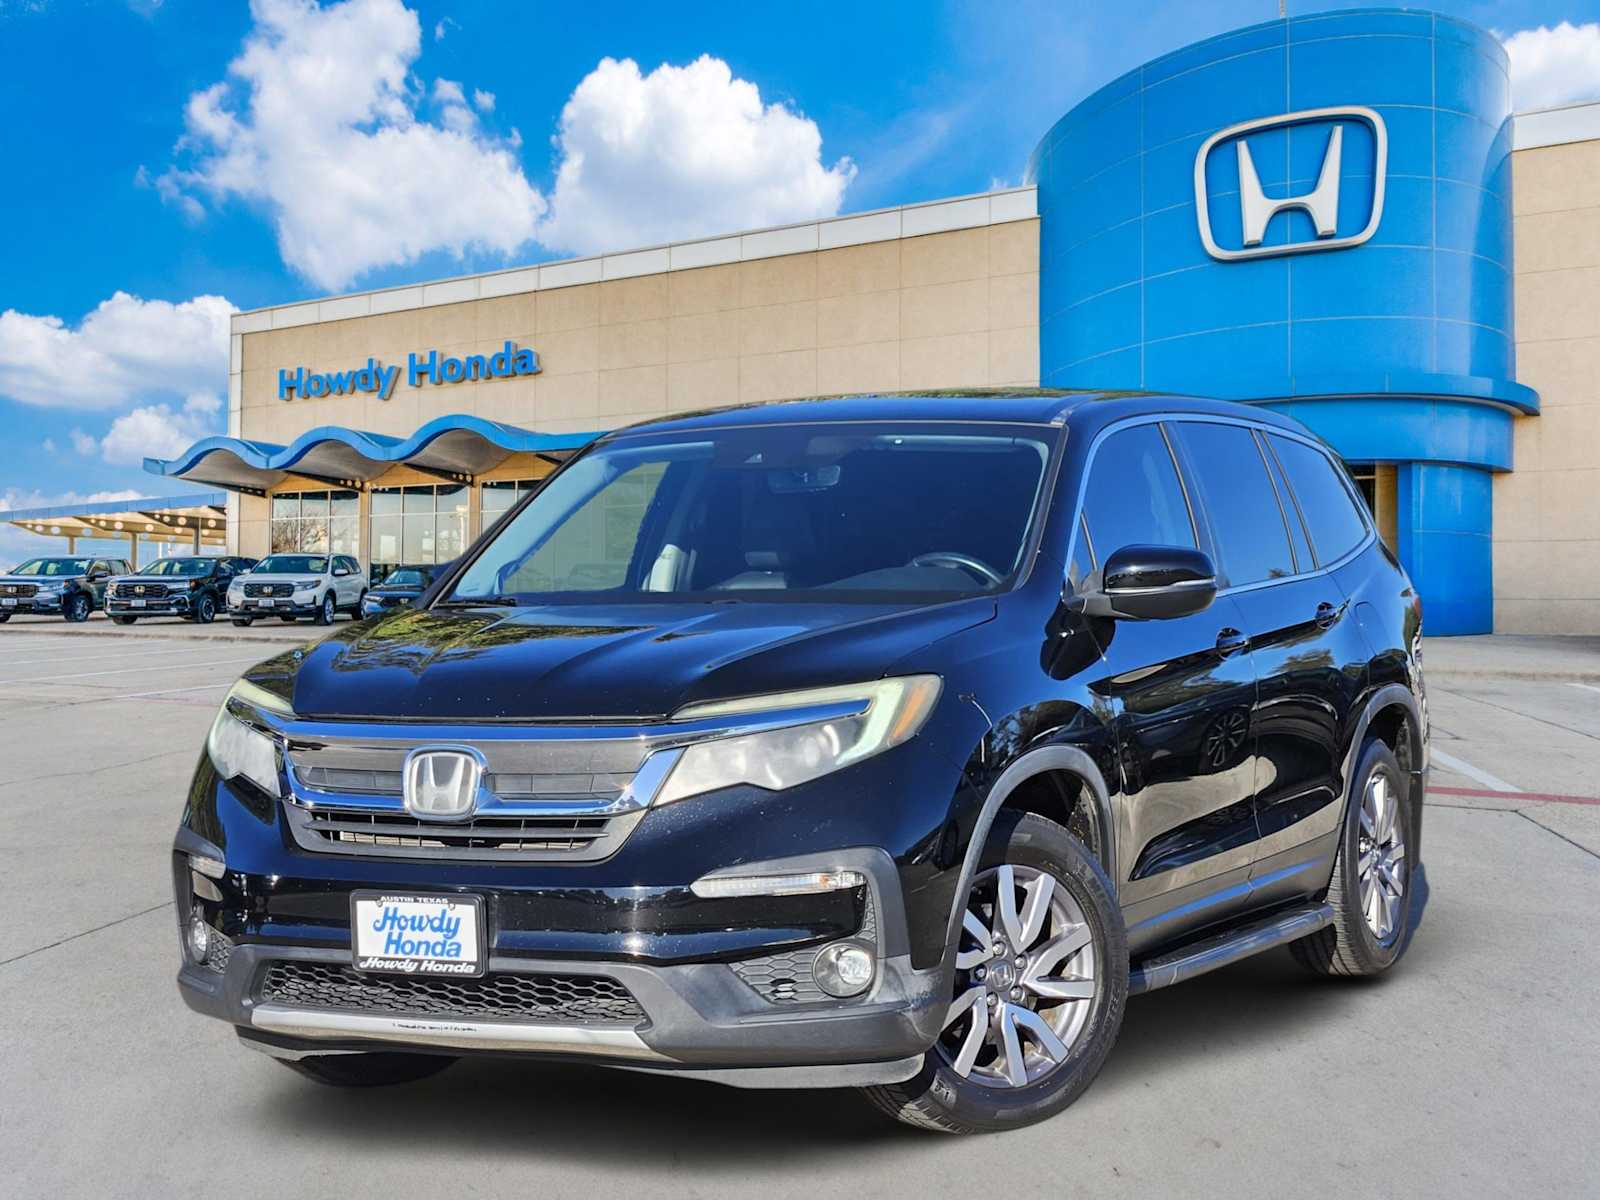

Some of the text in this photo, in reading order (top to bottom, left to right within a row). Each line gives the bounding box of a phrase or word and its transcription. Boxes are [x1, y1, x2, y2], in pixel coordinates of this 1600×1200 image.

[278, 340, 543, 401] Howdy Honda
[373, 906, 461, 940] Howdy
[383, 932, 462, 958] Honda
[359, 957, 476, 973] Howdy Honda
